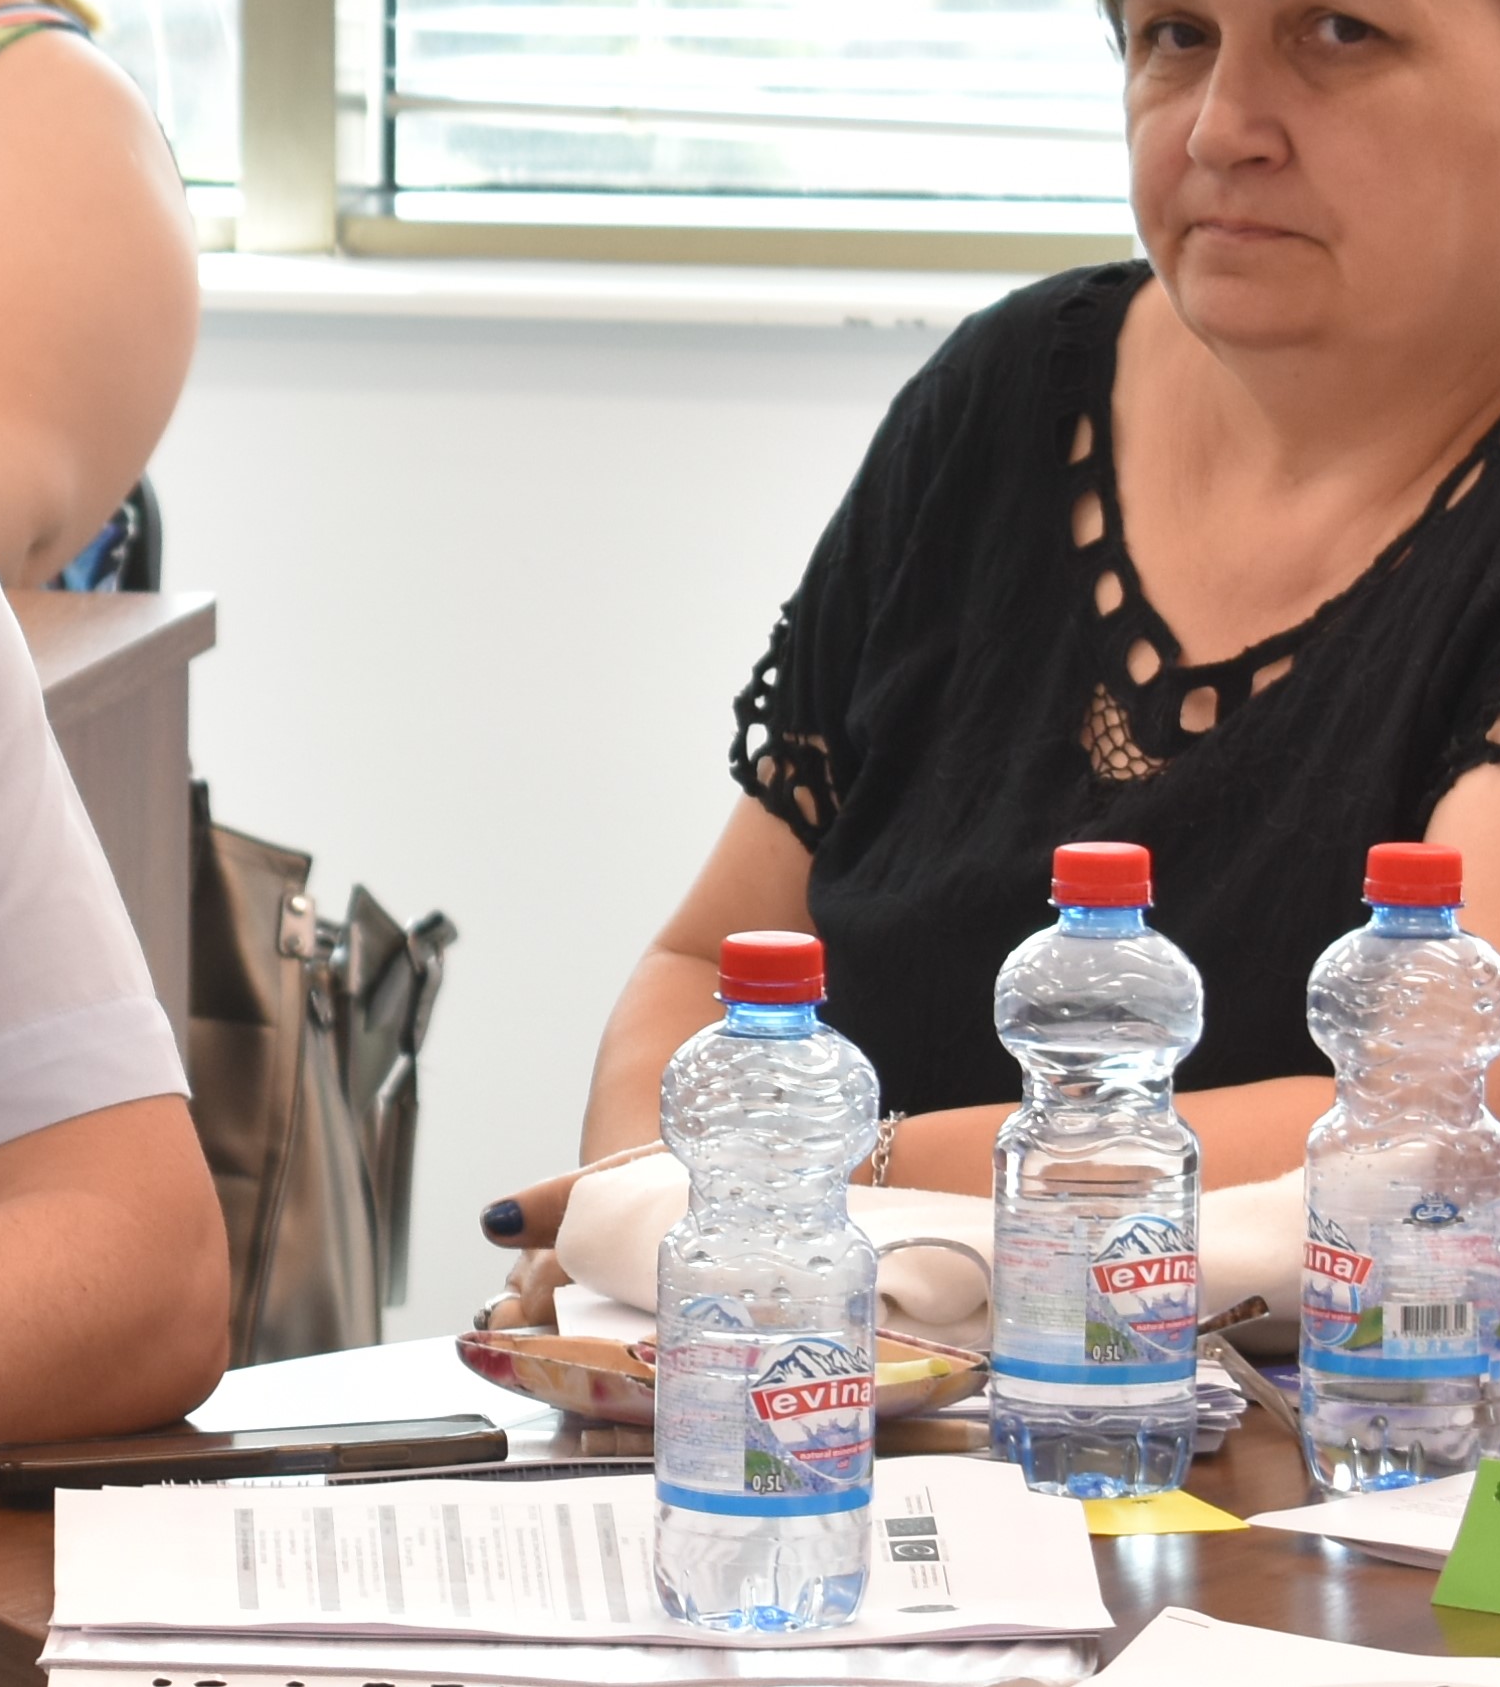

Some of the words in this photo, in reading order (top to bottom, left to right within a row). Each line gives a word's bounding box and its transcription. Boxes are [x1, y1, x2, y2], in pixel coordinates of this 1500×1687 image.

[1111, 1258, 1196, 1288] evina
[1093, 1345, 1120, 1363] 0,5L
[771, 1381, 872, 1414] evina
[752, 1474, 784, 1495] 0,5L
